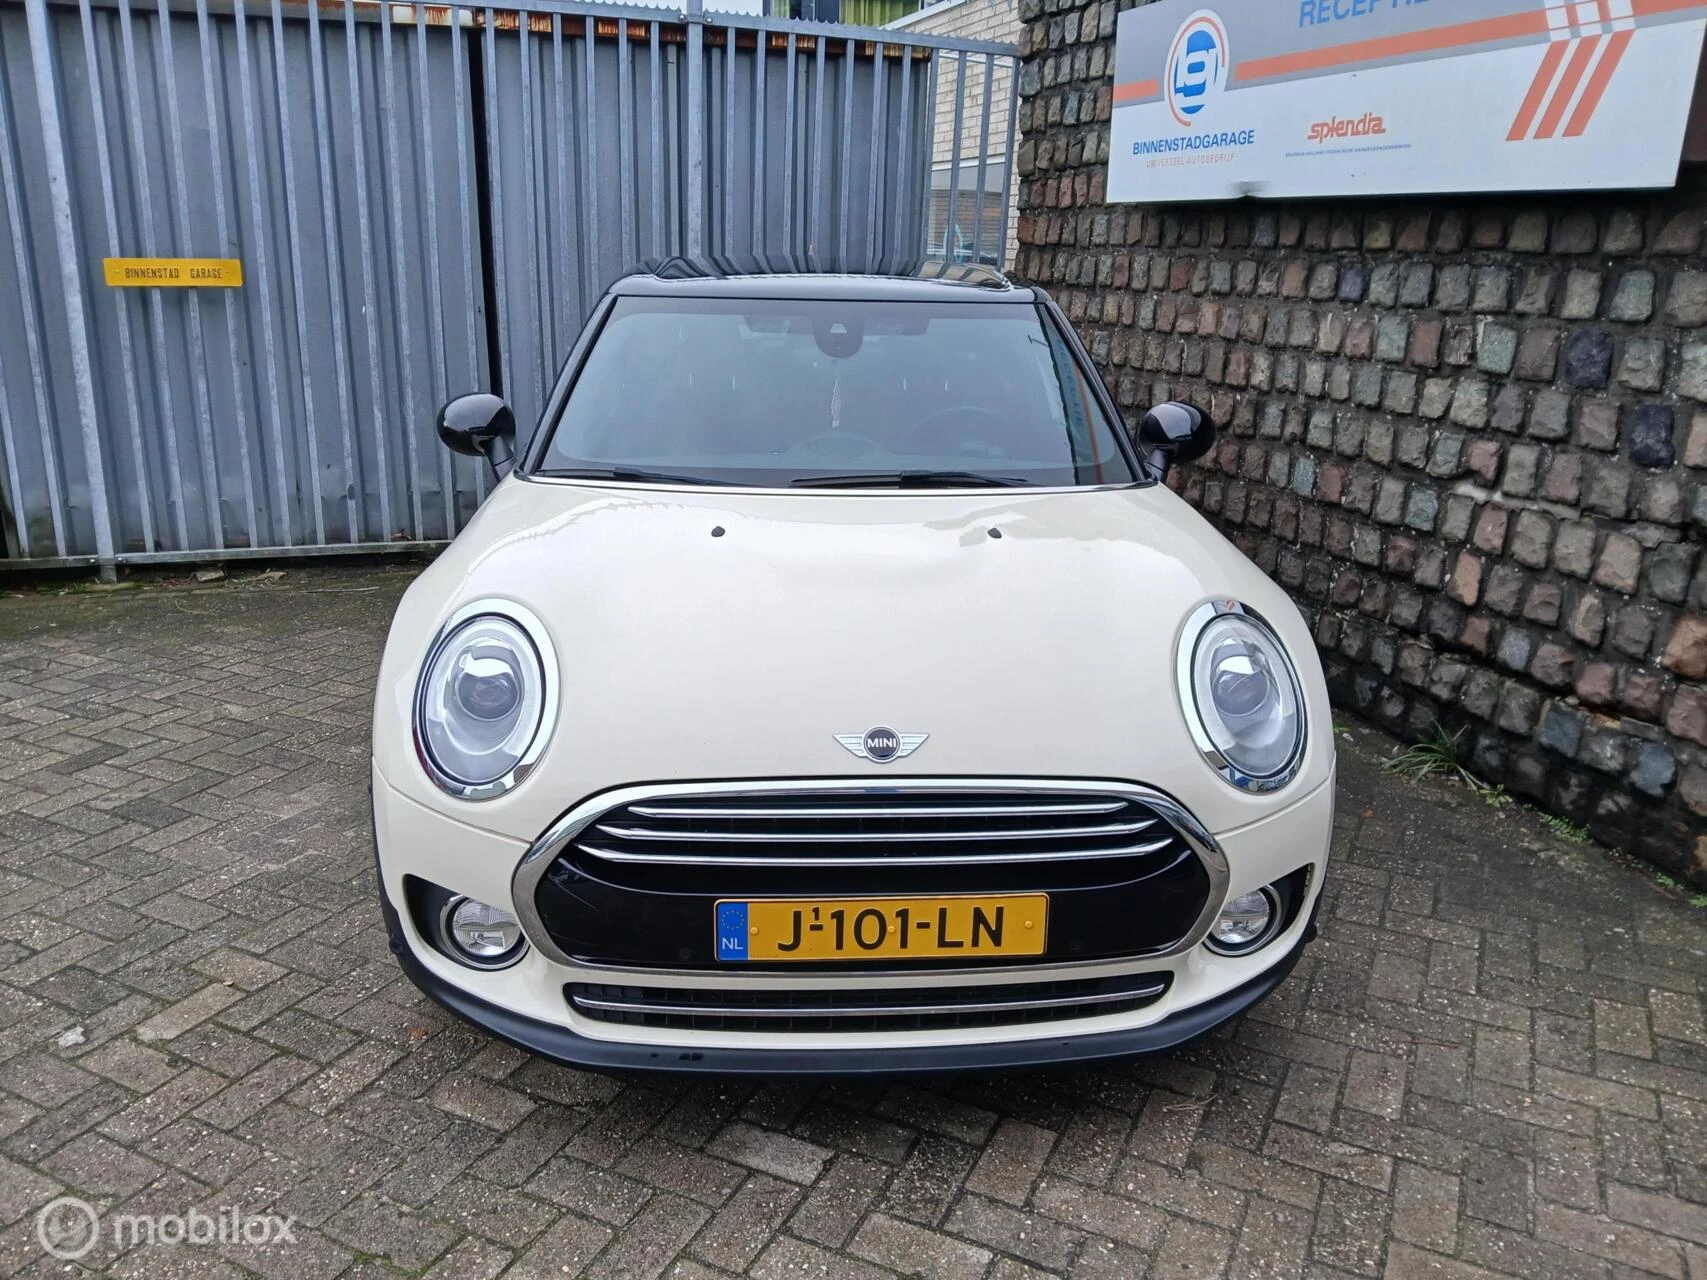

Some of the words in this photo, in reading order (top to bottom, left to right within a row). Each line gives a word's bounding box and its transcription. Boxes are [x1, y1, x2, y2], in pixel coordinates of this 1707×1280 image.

[1307, 112, 1386, 144] splendia
[1132, 129, 1255, 155] BINNENSTADGARAGE
[124, 267, 179, 279] BINNENSTAD
[189, 267, 223, 279] GARAGE
[867, 737, 897, 748] MINI
[721, 937, 744, 950] NL
